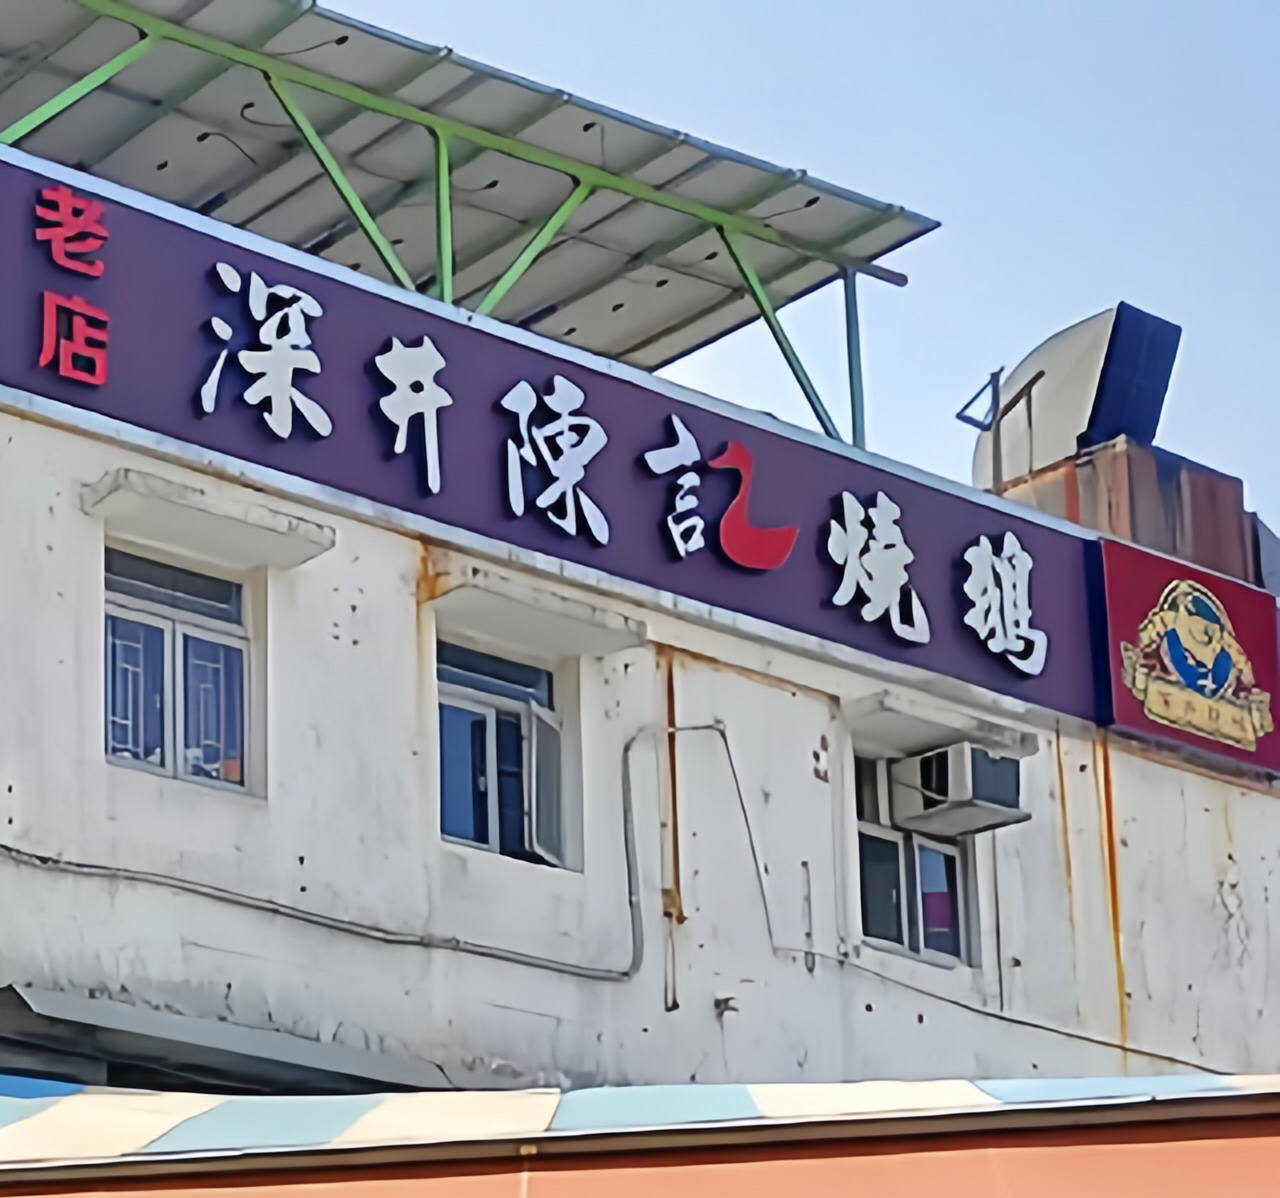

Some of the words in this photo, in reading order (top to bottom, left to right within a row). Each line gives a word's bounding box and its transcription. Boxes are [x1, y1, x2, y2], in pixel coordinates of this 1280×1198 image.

[35, 184, 109, 386] 老店
[201, 261, 1049, 677] 深井陳記燒鵝
